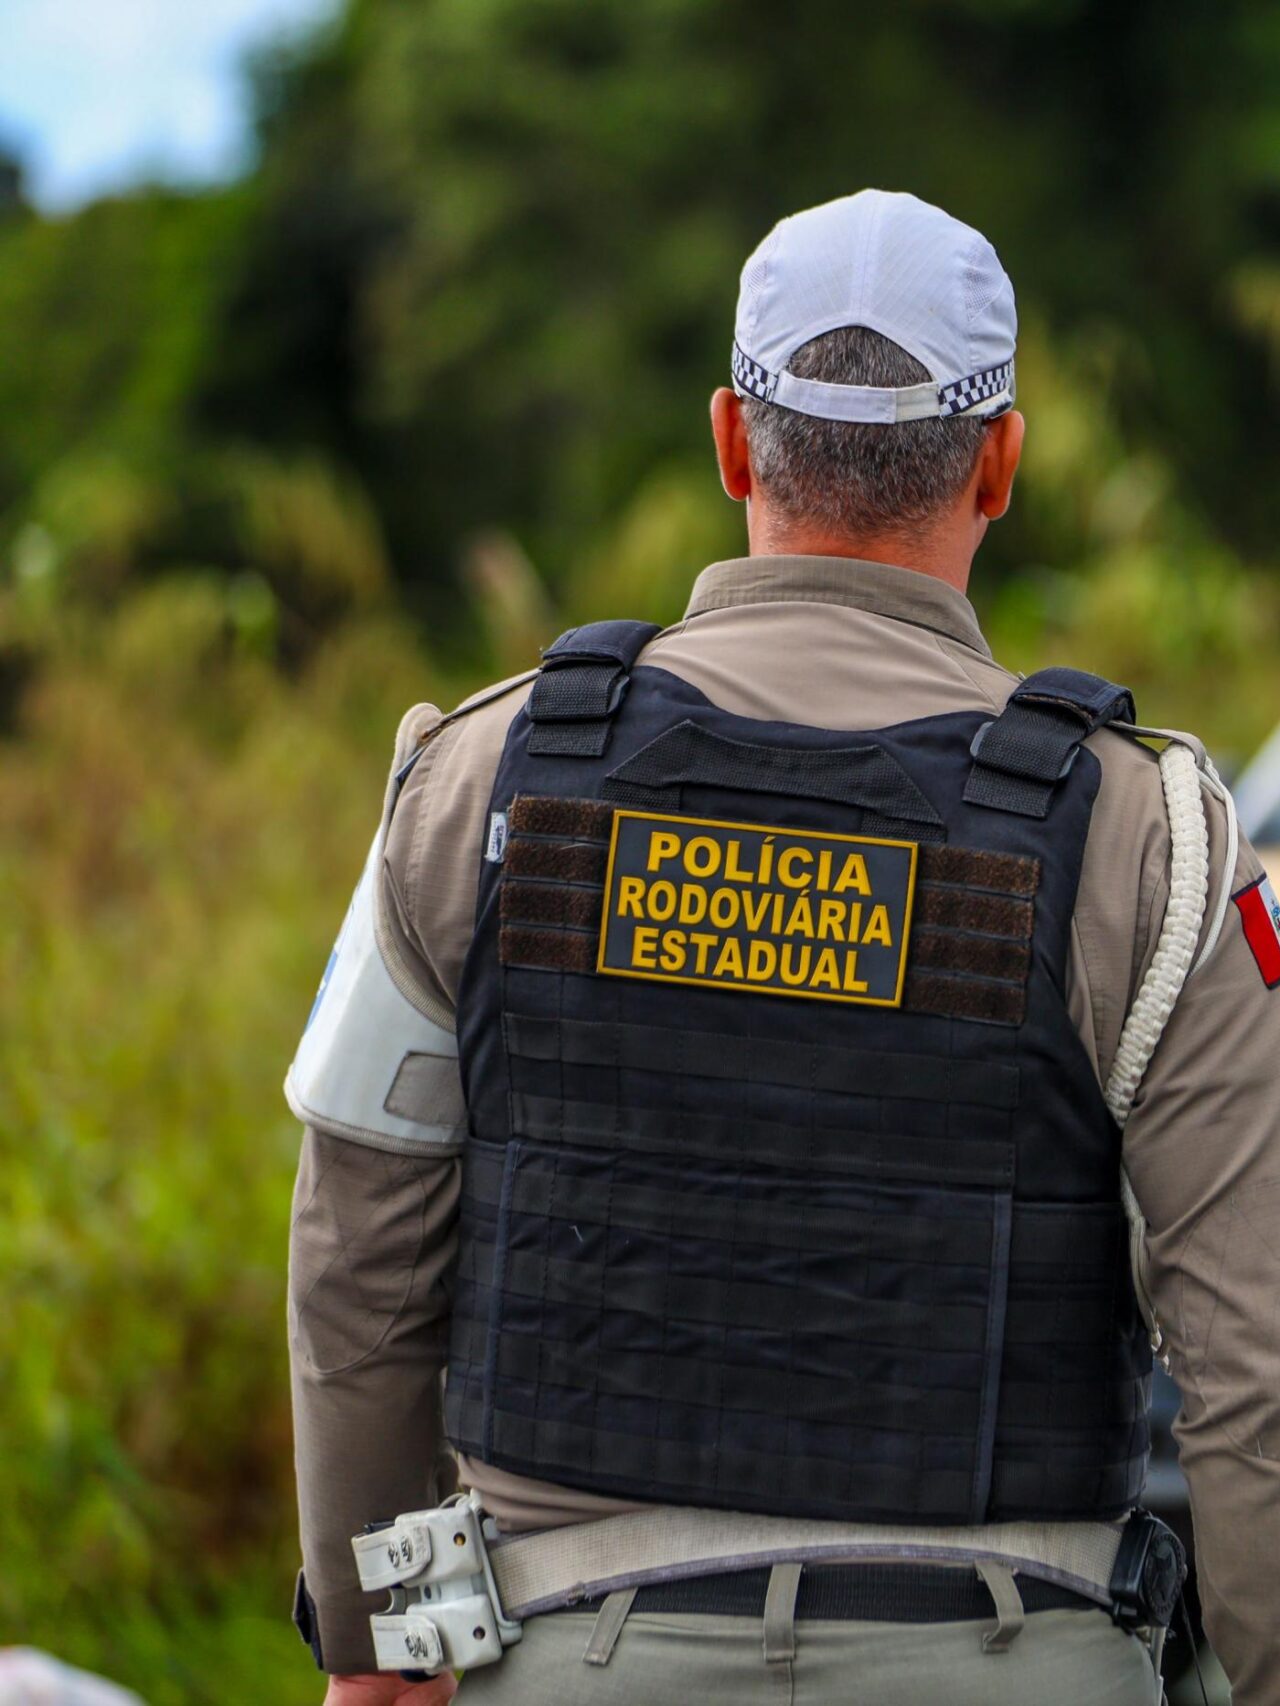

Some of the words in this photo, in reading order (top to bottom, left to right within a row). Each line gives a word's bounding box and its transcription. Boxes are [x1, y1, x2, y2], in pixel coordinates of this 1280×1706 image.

[646, 831, 873, 896] POLÍCIA
[616, 876, 893, 946] RODOVIÁRIA
[631, 926, 869, 993] ESTADUAL
